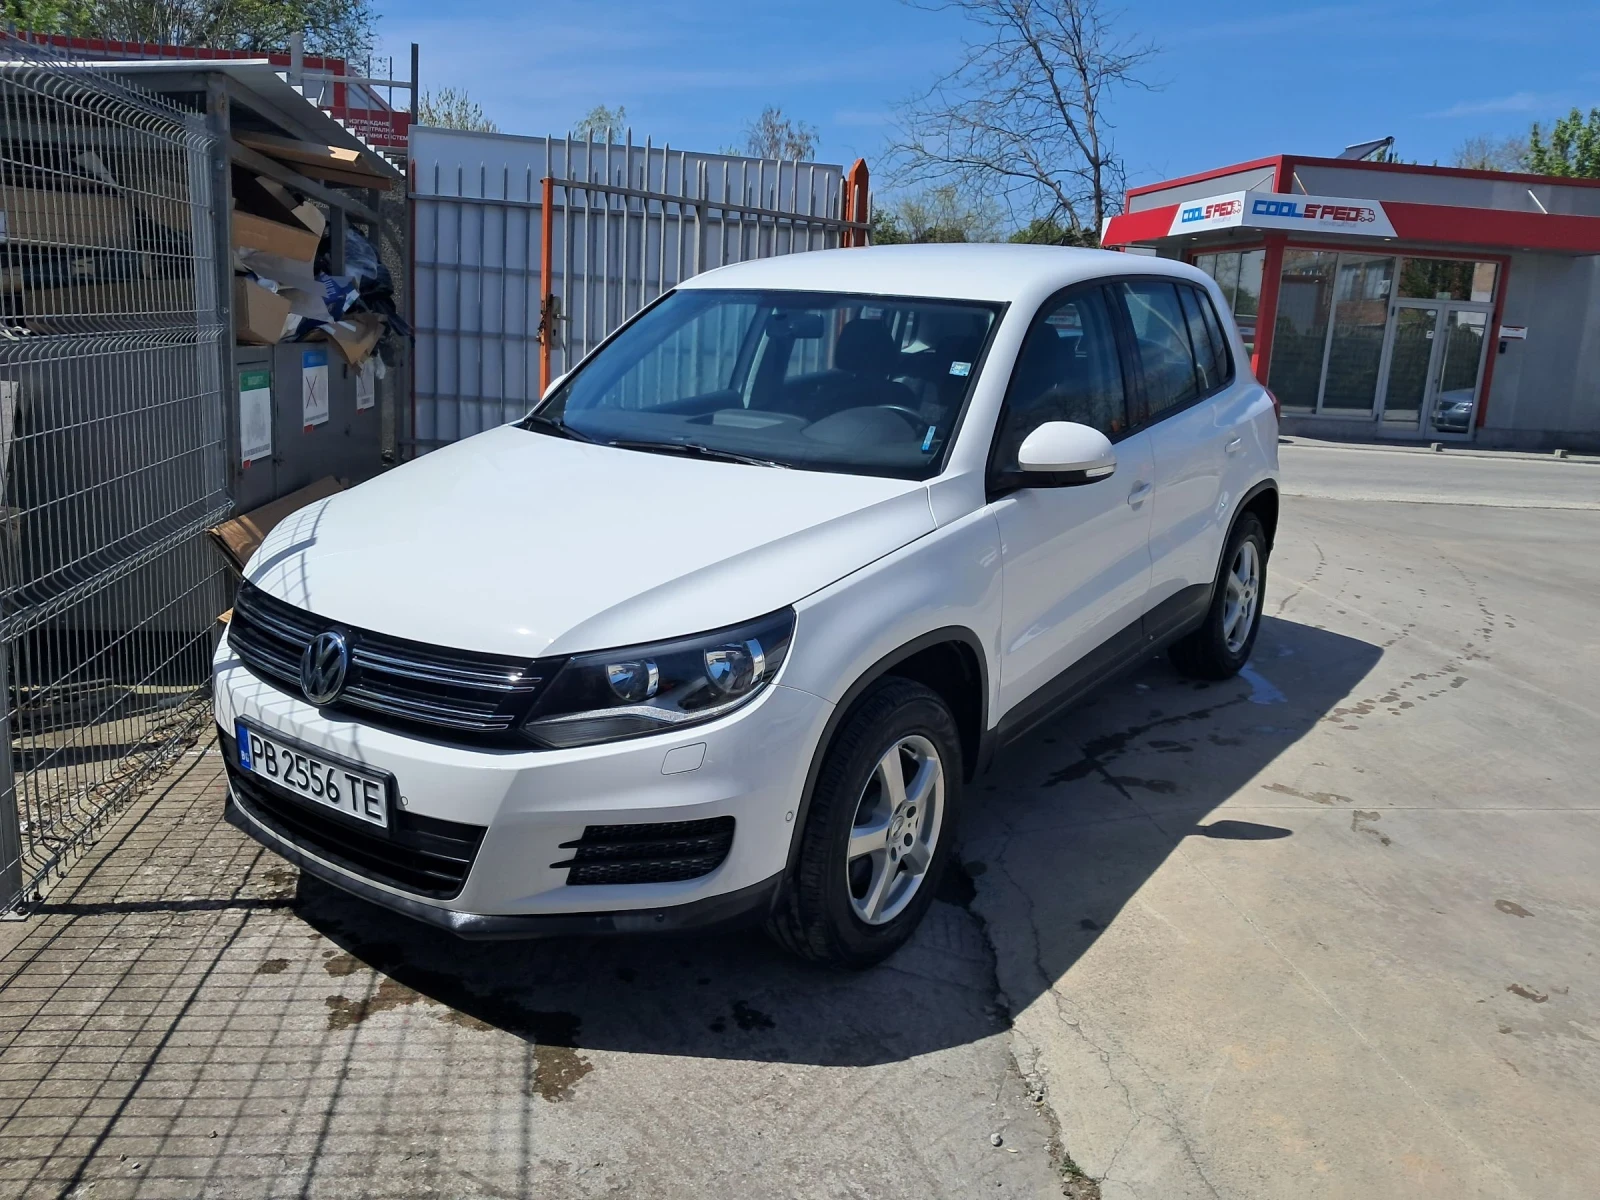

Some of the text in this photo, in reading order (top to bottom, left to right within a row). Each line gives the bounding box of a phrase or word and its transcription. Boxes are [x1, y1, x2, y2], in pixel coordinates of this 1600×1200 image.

[251, 734, 383, 820] PB 2556 TE
